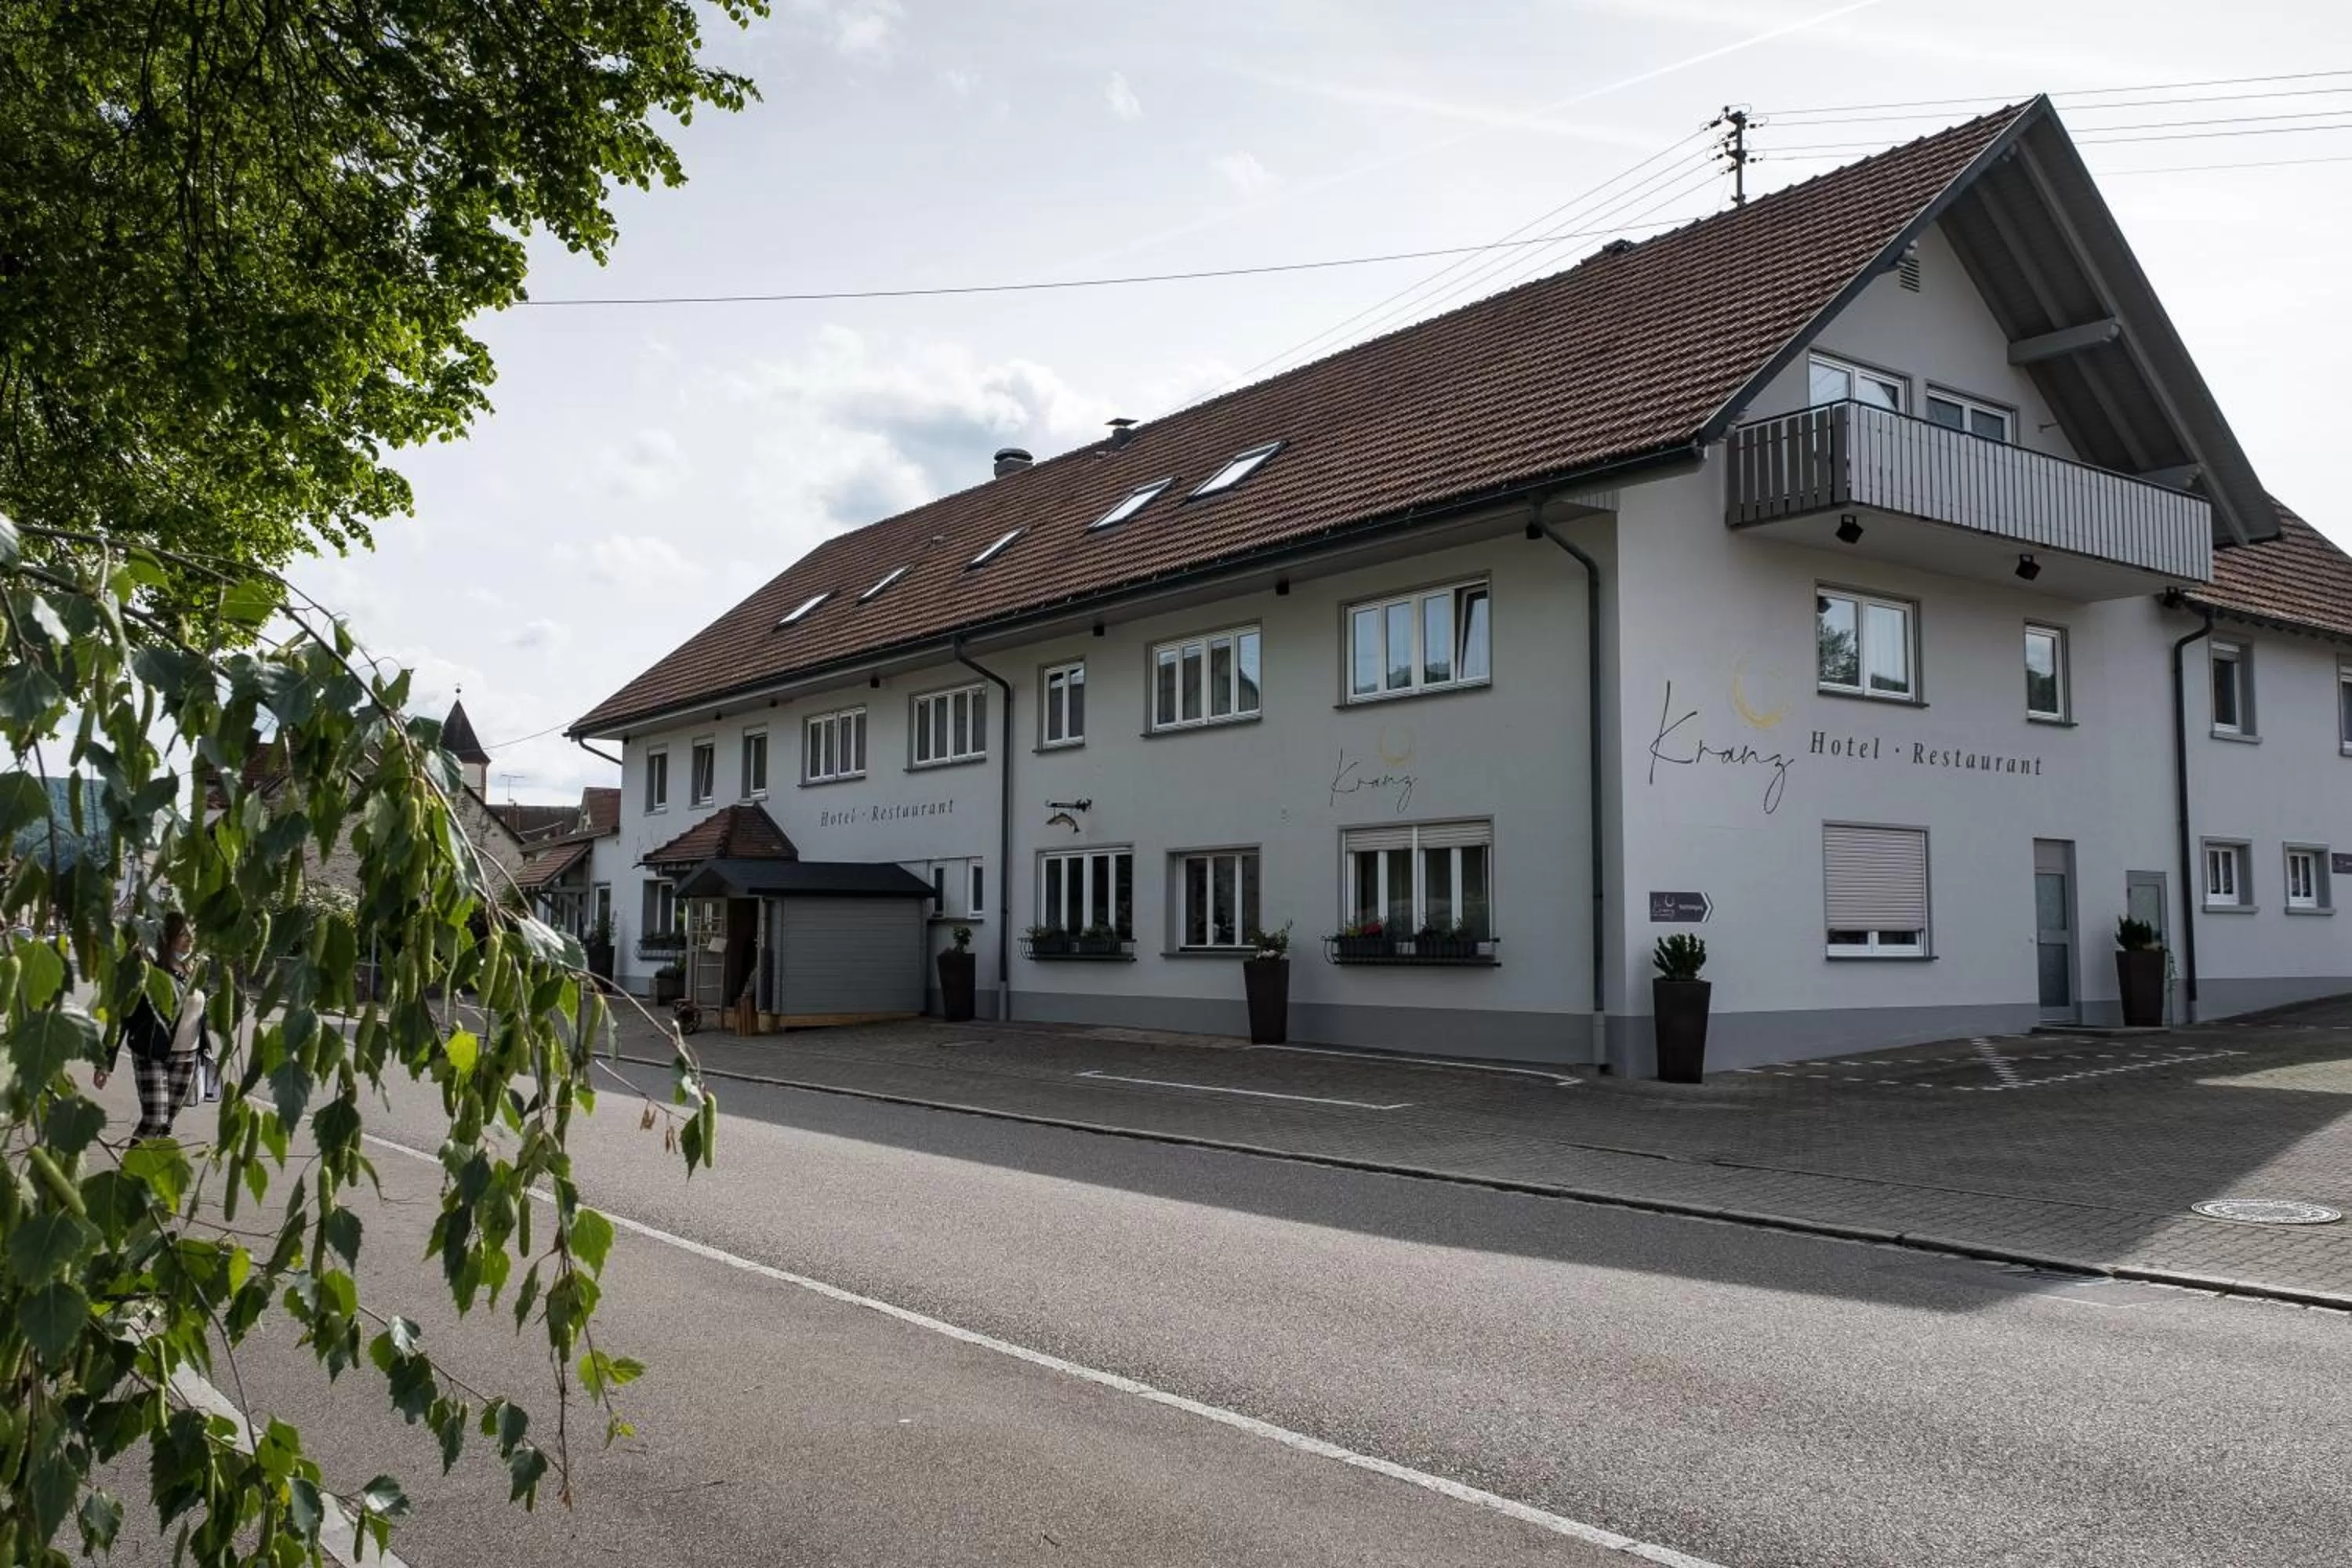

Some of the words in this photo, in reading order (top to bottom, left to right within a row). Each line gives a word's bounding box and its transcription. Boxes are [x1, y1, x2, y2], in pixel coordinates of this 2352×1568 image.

[1649, 680, 1794, 815] Kranz
[1809, 730, 1880, 759] Hotel
[1912, 742, 2042, 775] Restaurant
[1330, 746, 1418, 813] Kranz
[820, 807, 856, 827] Hotel
[871, 798, 954, 822] Restaurant
